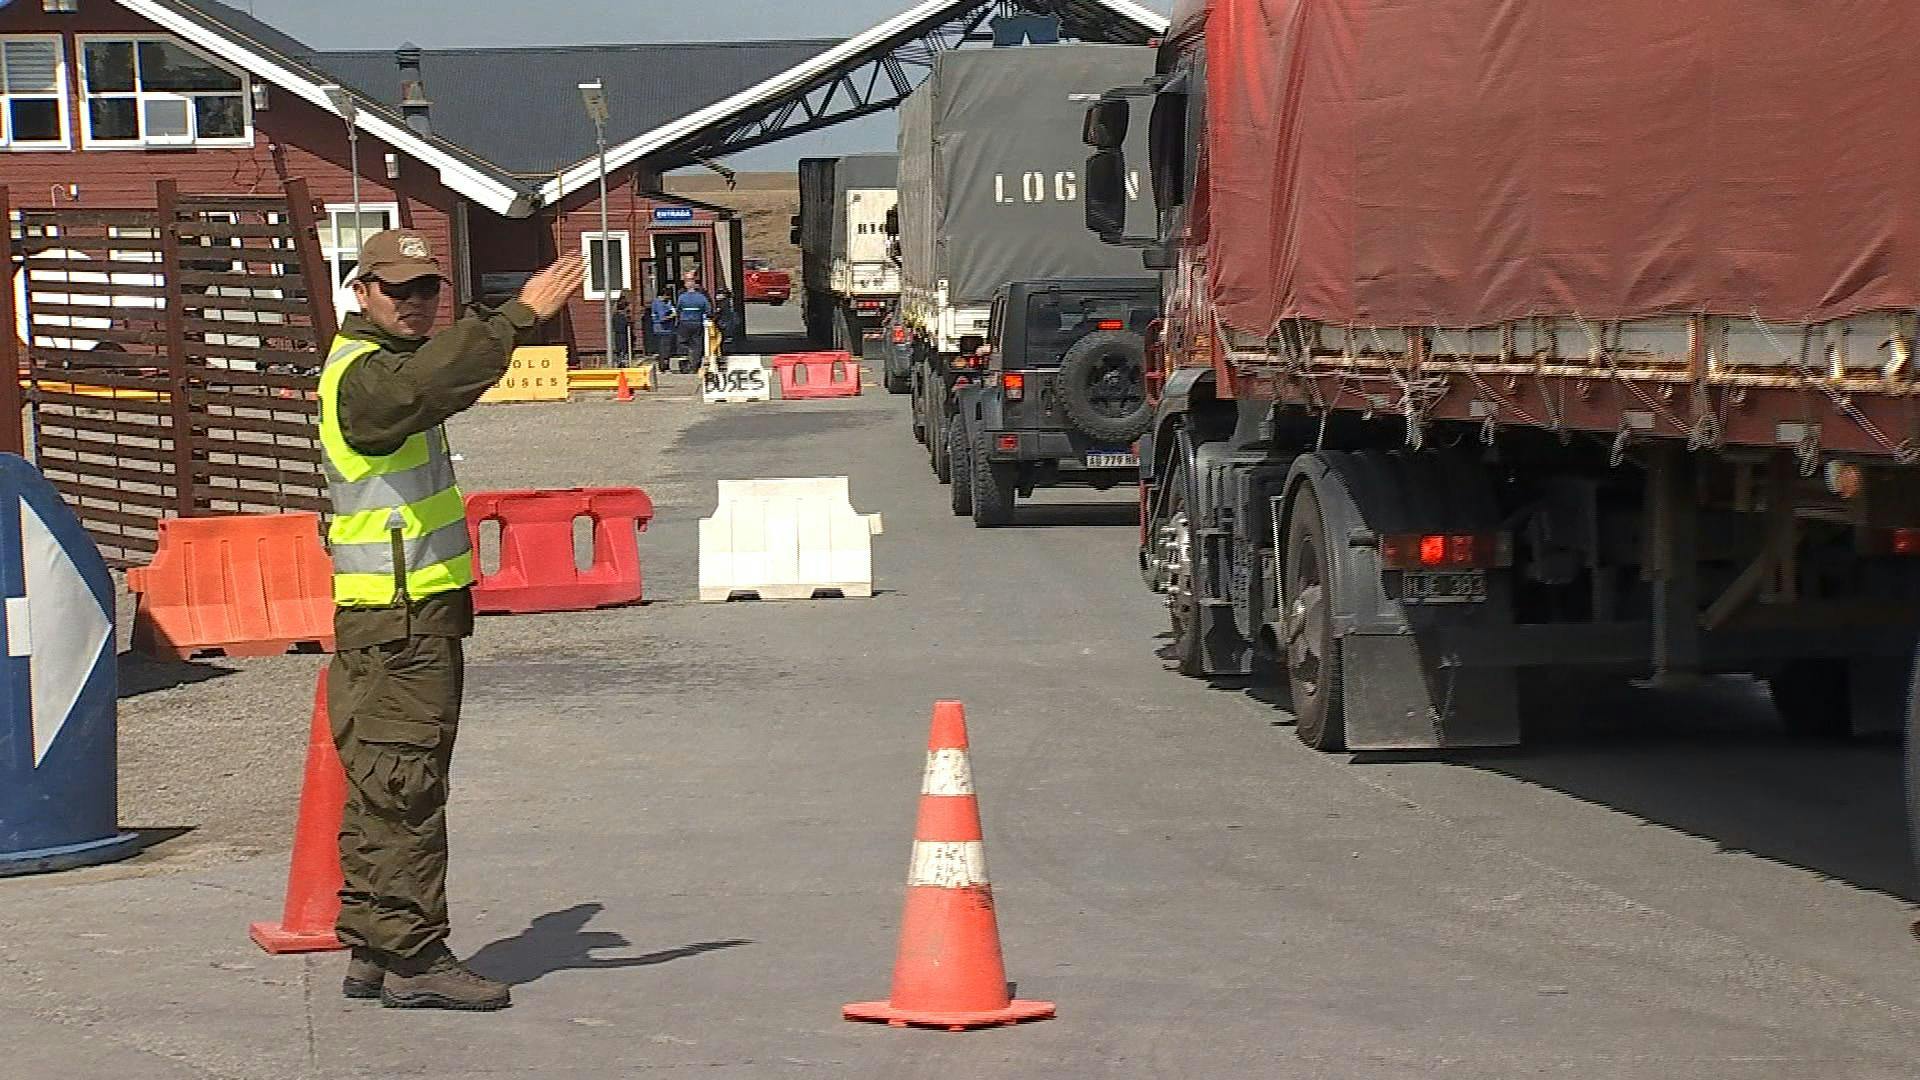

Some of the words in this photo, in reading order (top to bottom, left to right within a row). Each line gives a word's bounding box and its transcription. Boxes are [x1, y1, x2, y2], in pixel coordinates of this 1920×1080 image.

[994, 171, 1140, 204] LOGN
[512, 359, 551, 369] OLO
[704, 369, 766, 393] BUSES
